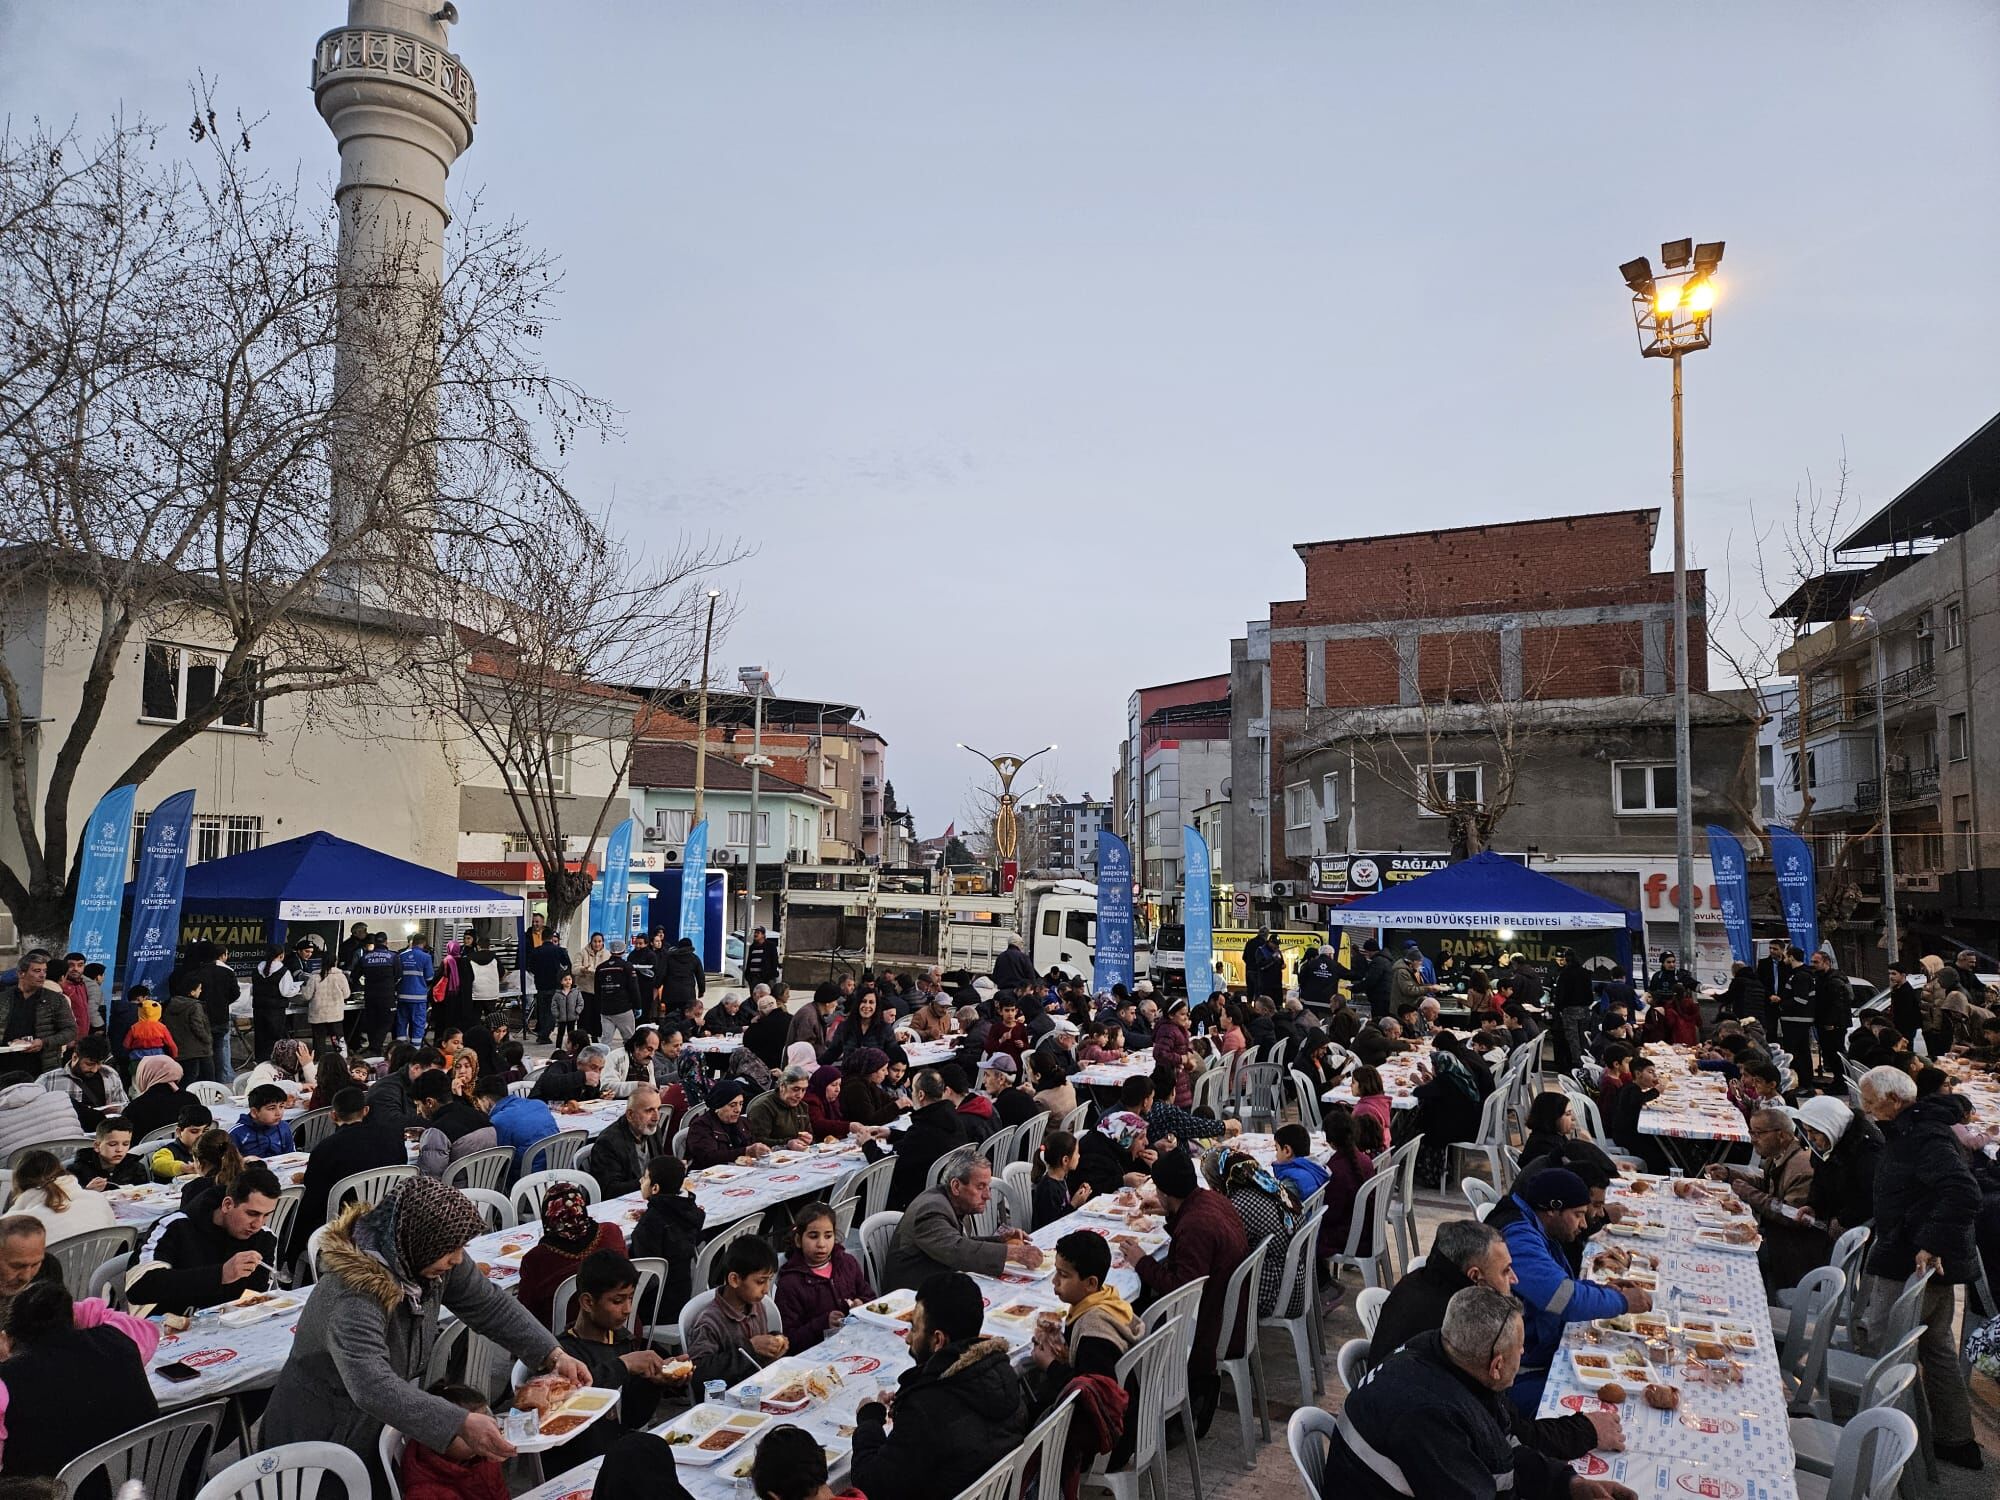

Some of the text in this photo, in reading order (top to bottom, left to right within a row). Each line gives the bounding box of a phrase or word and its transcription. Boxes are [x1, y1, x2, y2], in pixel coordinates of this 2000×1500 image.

[1391, 857, 1449, 870] SAĞLAM
[327, 906, 342, 915] T.C.
[345, 906, 371, 915] AYDIN
[373, 903, 436, 917] BÜYÜKŞEHİR
[438, 905, 481, 914] BELEDİYESİ
[1378, 914, 1394, 924] T.C.
[1395, 915, 1423, 924] AYDIN
[1426, 913, 1500, 927] BÜYÜKŞEHİR
[1504, 915, 1561, 926] BELEDİYESİ
[183, 926, 268, 945] MAZANL
[1281, 937, 1305, 945] LEDİYESİ
[84, 952, 111, 960] ÜKŞEHİR
